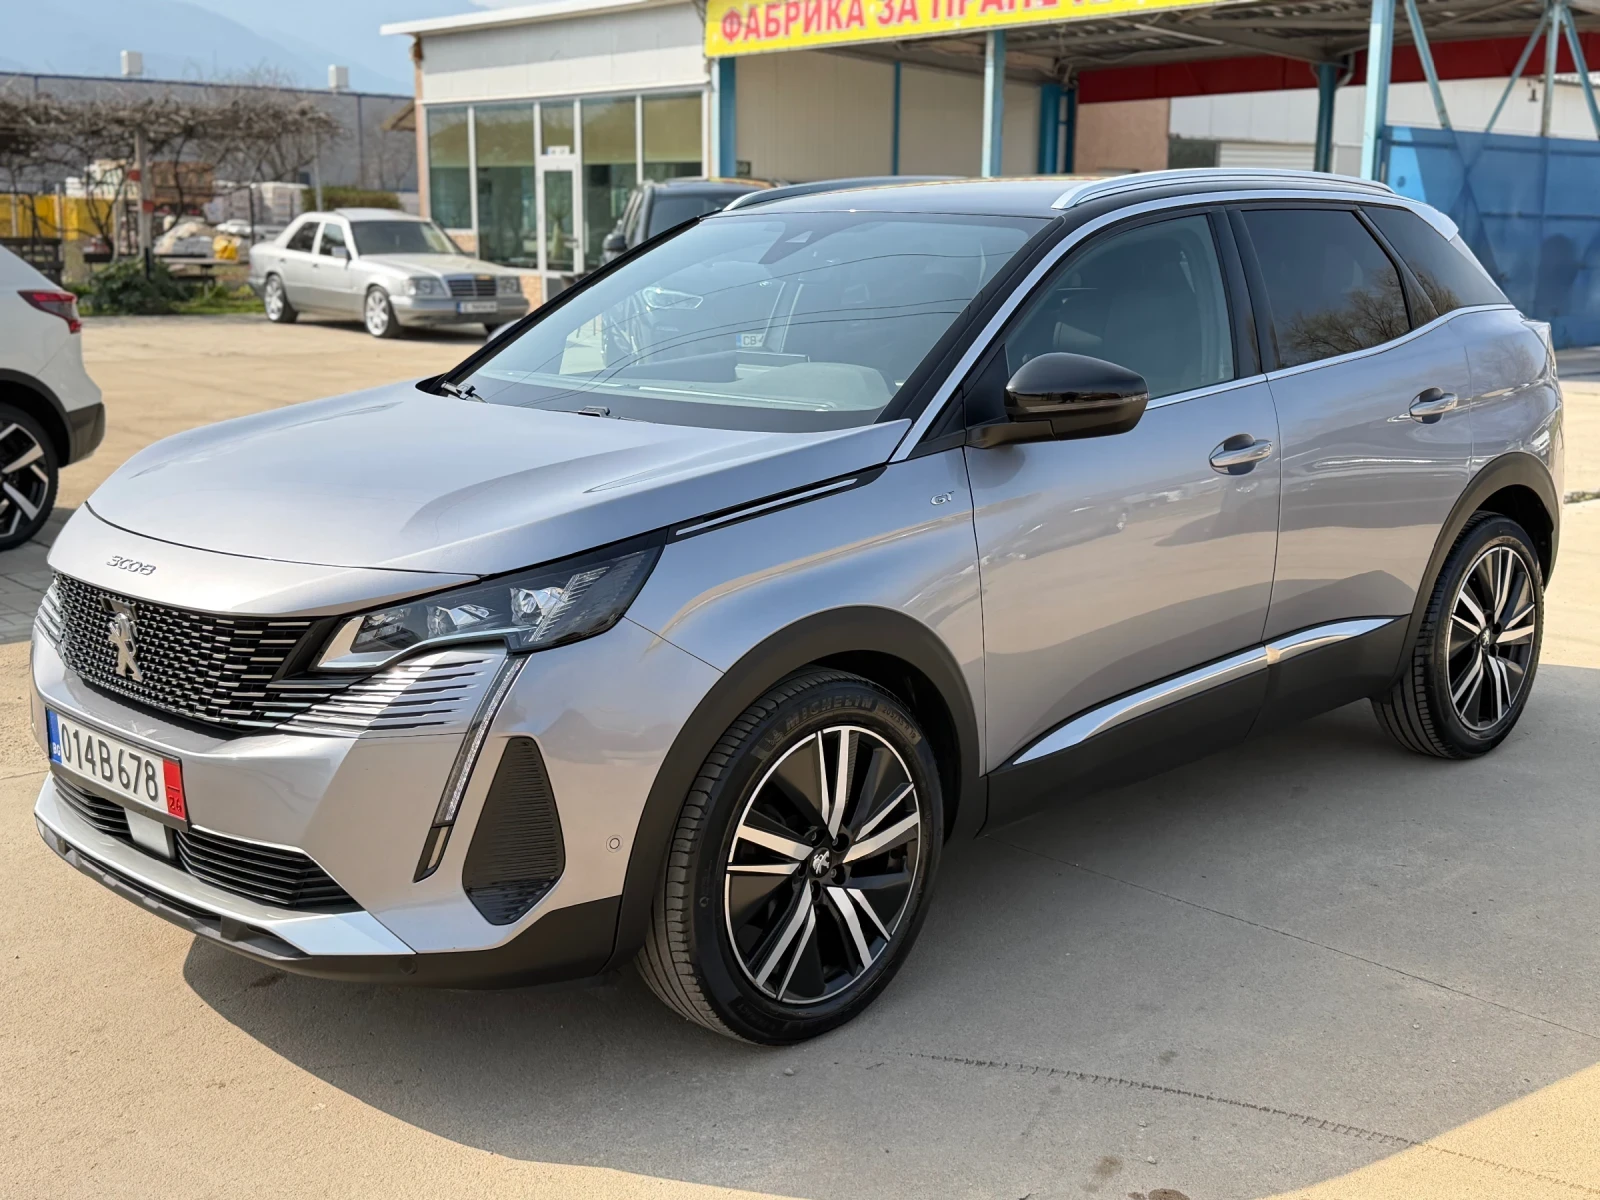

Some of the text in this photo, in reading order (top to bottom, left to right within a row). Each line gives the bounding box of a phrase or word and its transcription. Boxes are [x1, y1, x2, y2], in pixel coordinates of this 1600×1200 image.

[721, 0, 865, 42] ФАБРИКА
[878, 0, 918, 25] ЗА
[930, 490, 955, 506] GT
[106, 555, 157, 576] 3008
[785, 694, 873, 731] MICHELIN
[52, 741, 61, 757] BG
